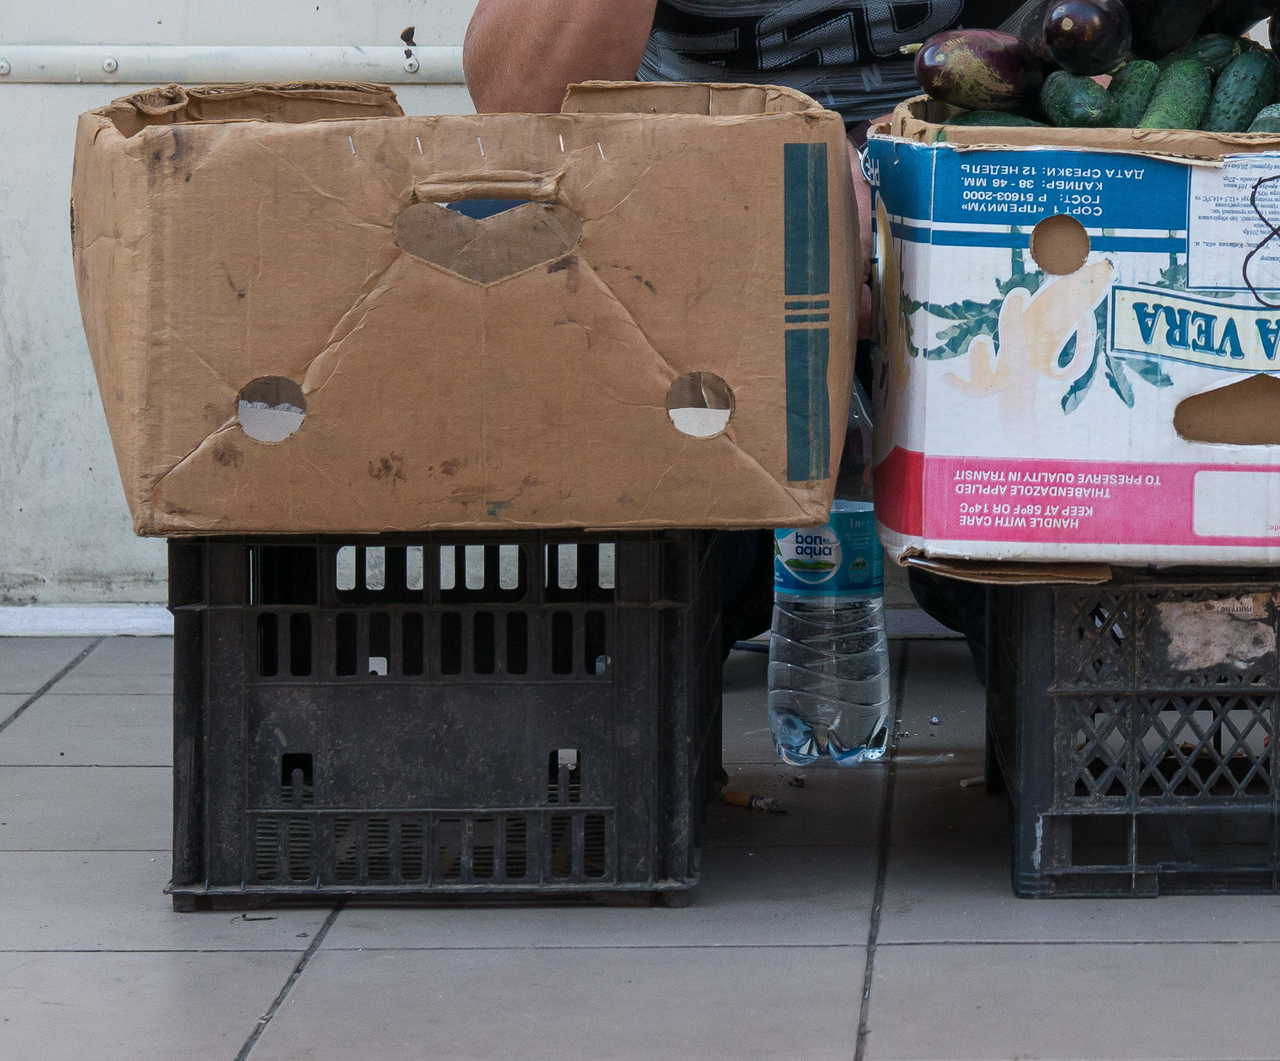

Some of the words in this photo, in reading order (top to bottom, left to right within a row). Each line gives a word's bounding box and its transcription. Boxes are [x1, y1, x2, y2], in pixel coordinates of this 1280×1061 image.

[961, 164, 1018, 174] НЕДЕЛЬ
[1042, 167, 1101, 178] СРЕЗКИ:
[1106, 169, 1144, 179] ДАТА
[961, 177, 987, 186] ММ.
[992, 179, 1008, 187] 46
[1018, 180, 1034, 188] 38
[1042, 180, 1102, 190] КАЛИБР:
[963, 191, 1034, 202] 51603-2000
[1060, 194, 1099, 204] ГОСТ:
[961, 202, 1044, 213] «ПРЕМИУМ»
[1053, 205, 1059, 213] 1
[1064, 205, 1102, 216] СОРТ
[1132, 303, 1244, 360] VERA
[954, 470, 1005, 481] TRANSIT
[1009, 471, 1021, 481] IN
[1023, 471, 1074, 483] QUALITY
[1078, 473, 1142, 484] PRESERVE
[1145, 475, 1160, 485] TO
[956, 483, 1007, 495] APPLIED
[1010, 485, 1110, 497] THIABENDAZOLE
[993, 503, 1010, 513] OR
[1045, 505, 1059, 515] AT
[1062, 506, 1093, 515] KEEP
[960, 515, 991, 526] CARE
[995, 516, 1026, 526] WITH
[1030, 517, 1078, 528] HANDLE
[796, 532, 823, 545] bon
[796, 545, 832, 558] aqua
